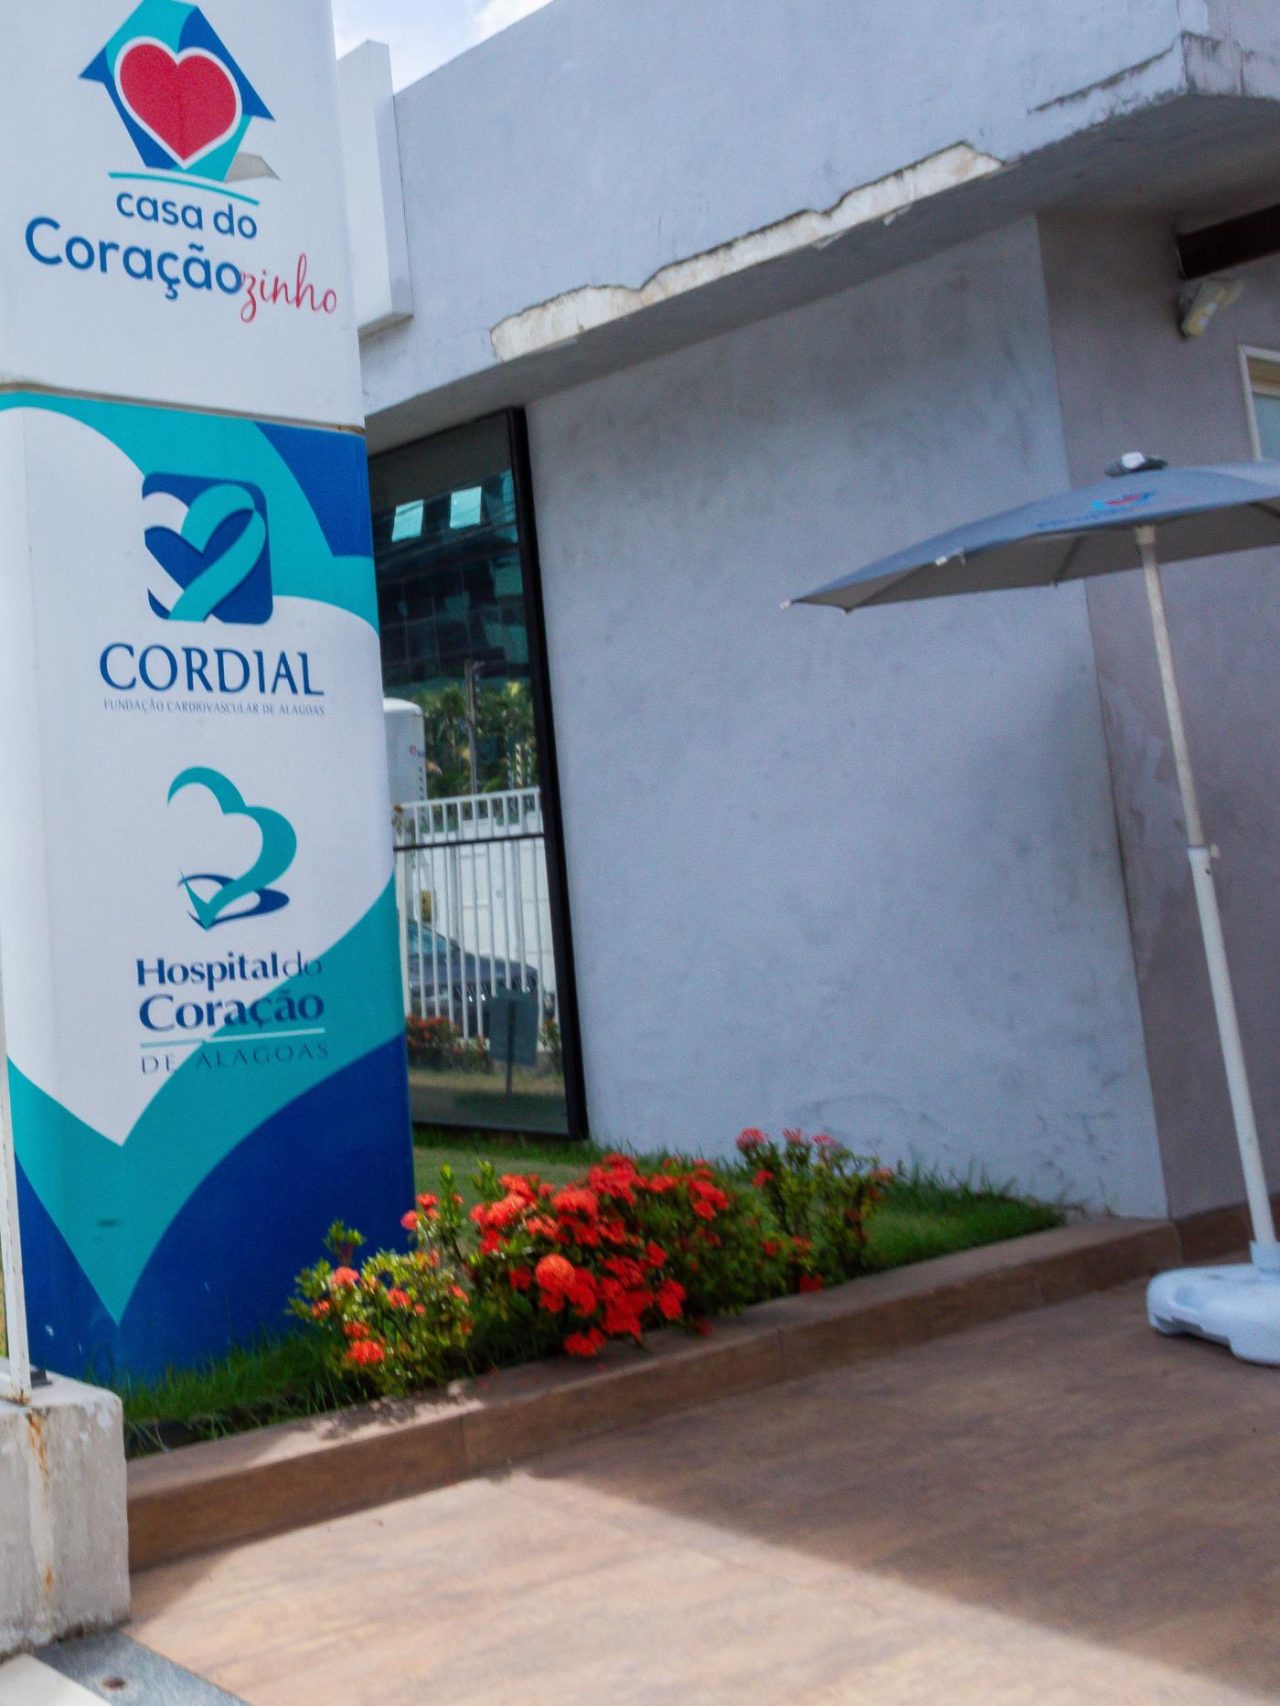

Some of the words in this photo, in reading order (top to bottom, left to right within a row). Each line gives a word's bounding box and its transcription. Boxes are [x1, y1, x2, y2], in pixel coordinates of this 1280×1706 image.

[116, 192, 203, 231] casa
[213, 203, 258, 239] do
[99, 642, 324, 695] CORDIAL
[104, 697, 163, 714] FUNDAÇÃO
[167, 700, 259, 714] CARDIOVASCULAR
[262, 703, 276, 715] DE
[279, 703, 325, 716] ALAGOAS
[136, 951, 279, 992] Hospital
[139, 989, 325, 1032] Coração
[141, 1055, 175, 1074] DE
[195, 1041, 329, 1070] ALAGOAS
